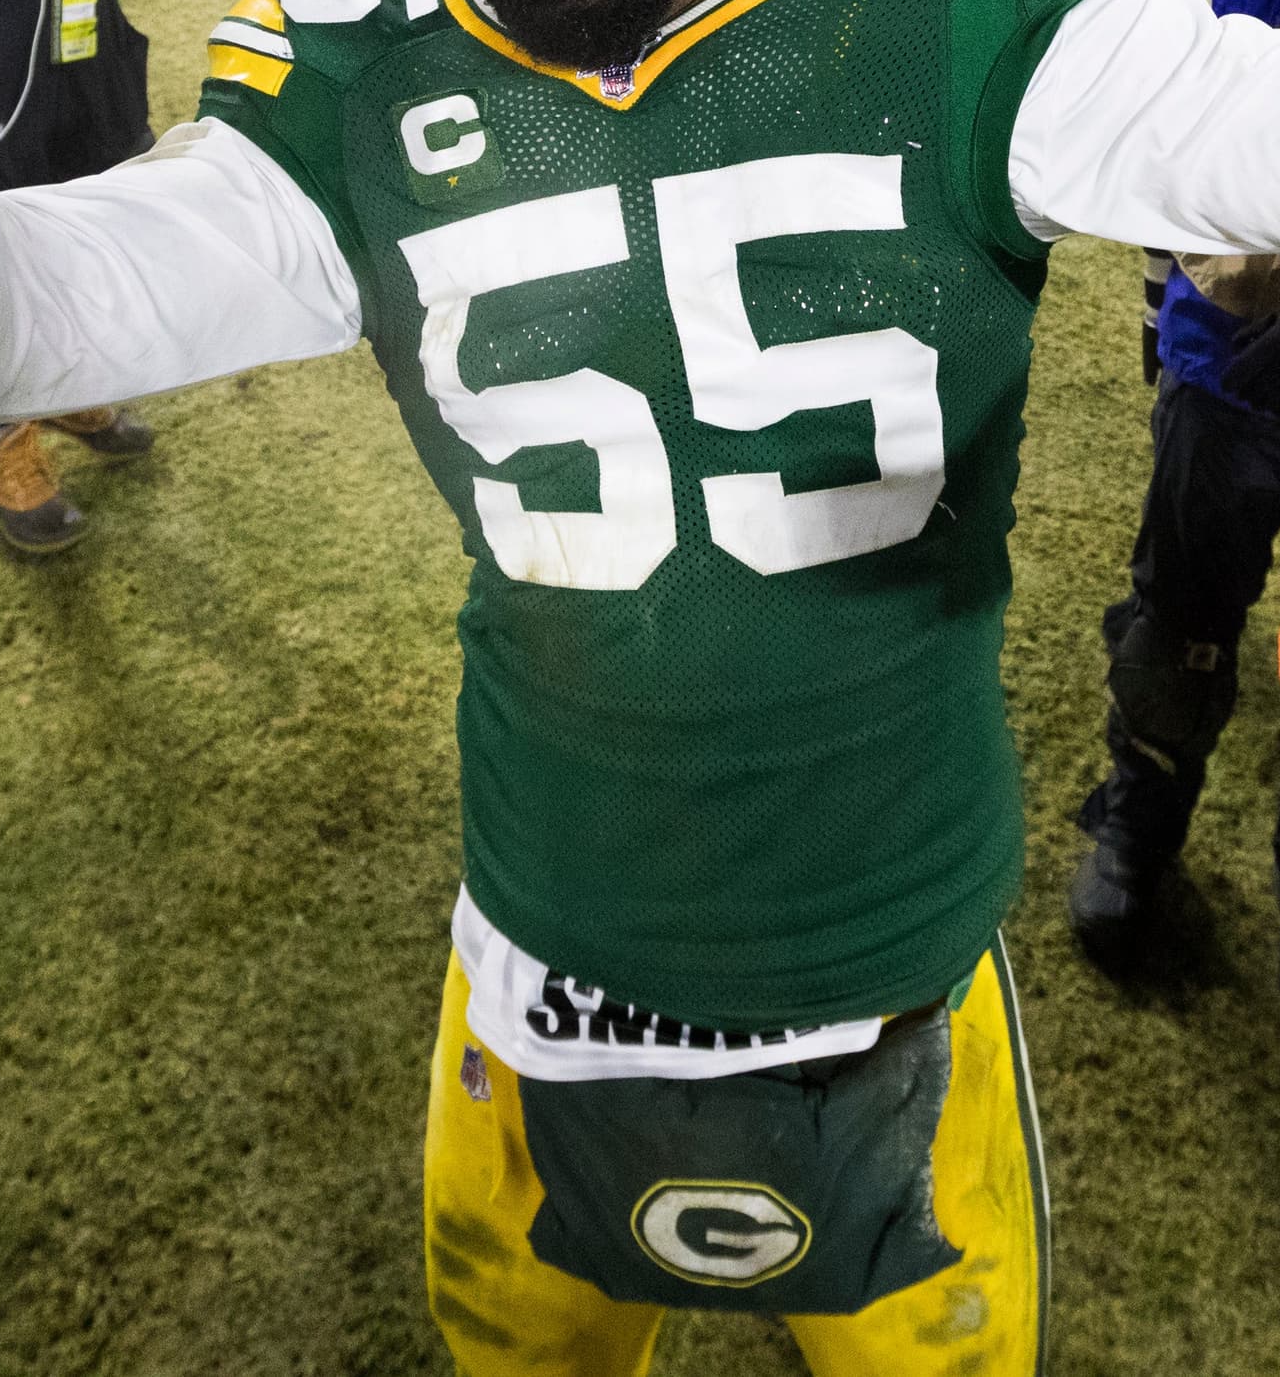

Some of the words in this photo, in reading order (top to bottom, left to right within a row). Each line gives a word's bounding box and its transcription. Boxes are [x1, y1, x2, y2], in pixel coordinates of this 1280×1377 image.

[400, 94, 487, 175] C
[397, 152, 946, 591] 55
[642, 1187, 801, 1280] G
